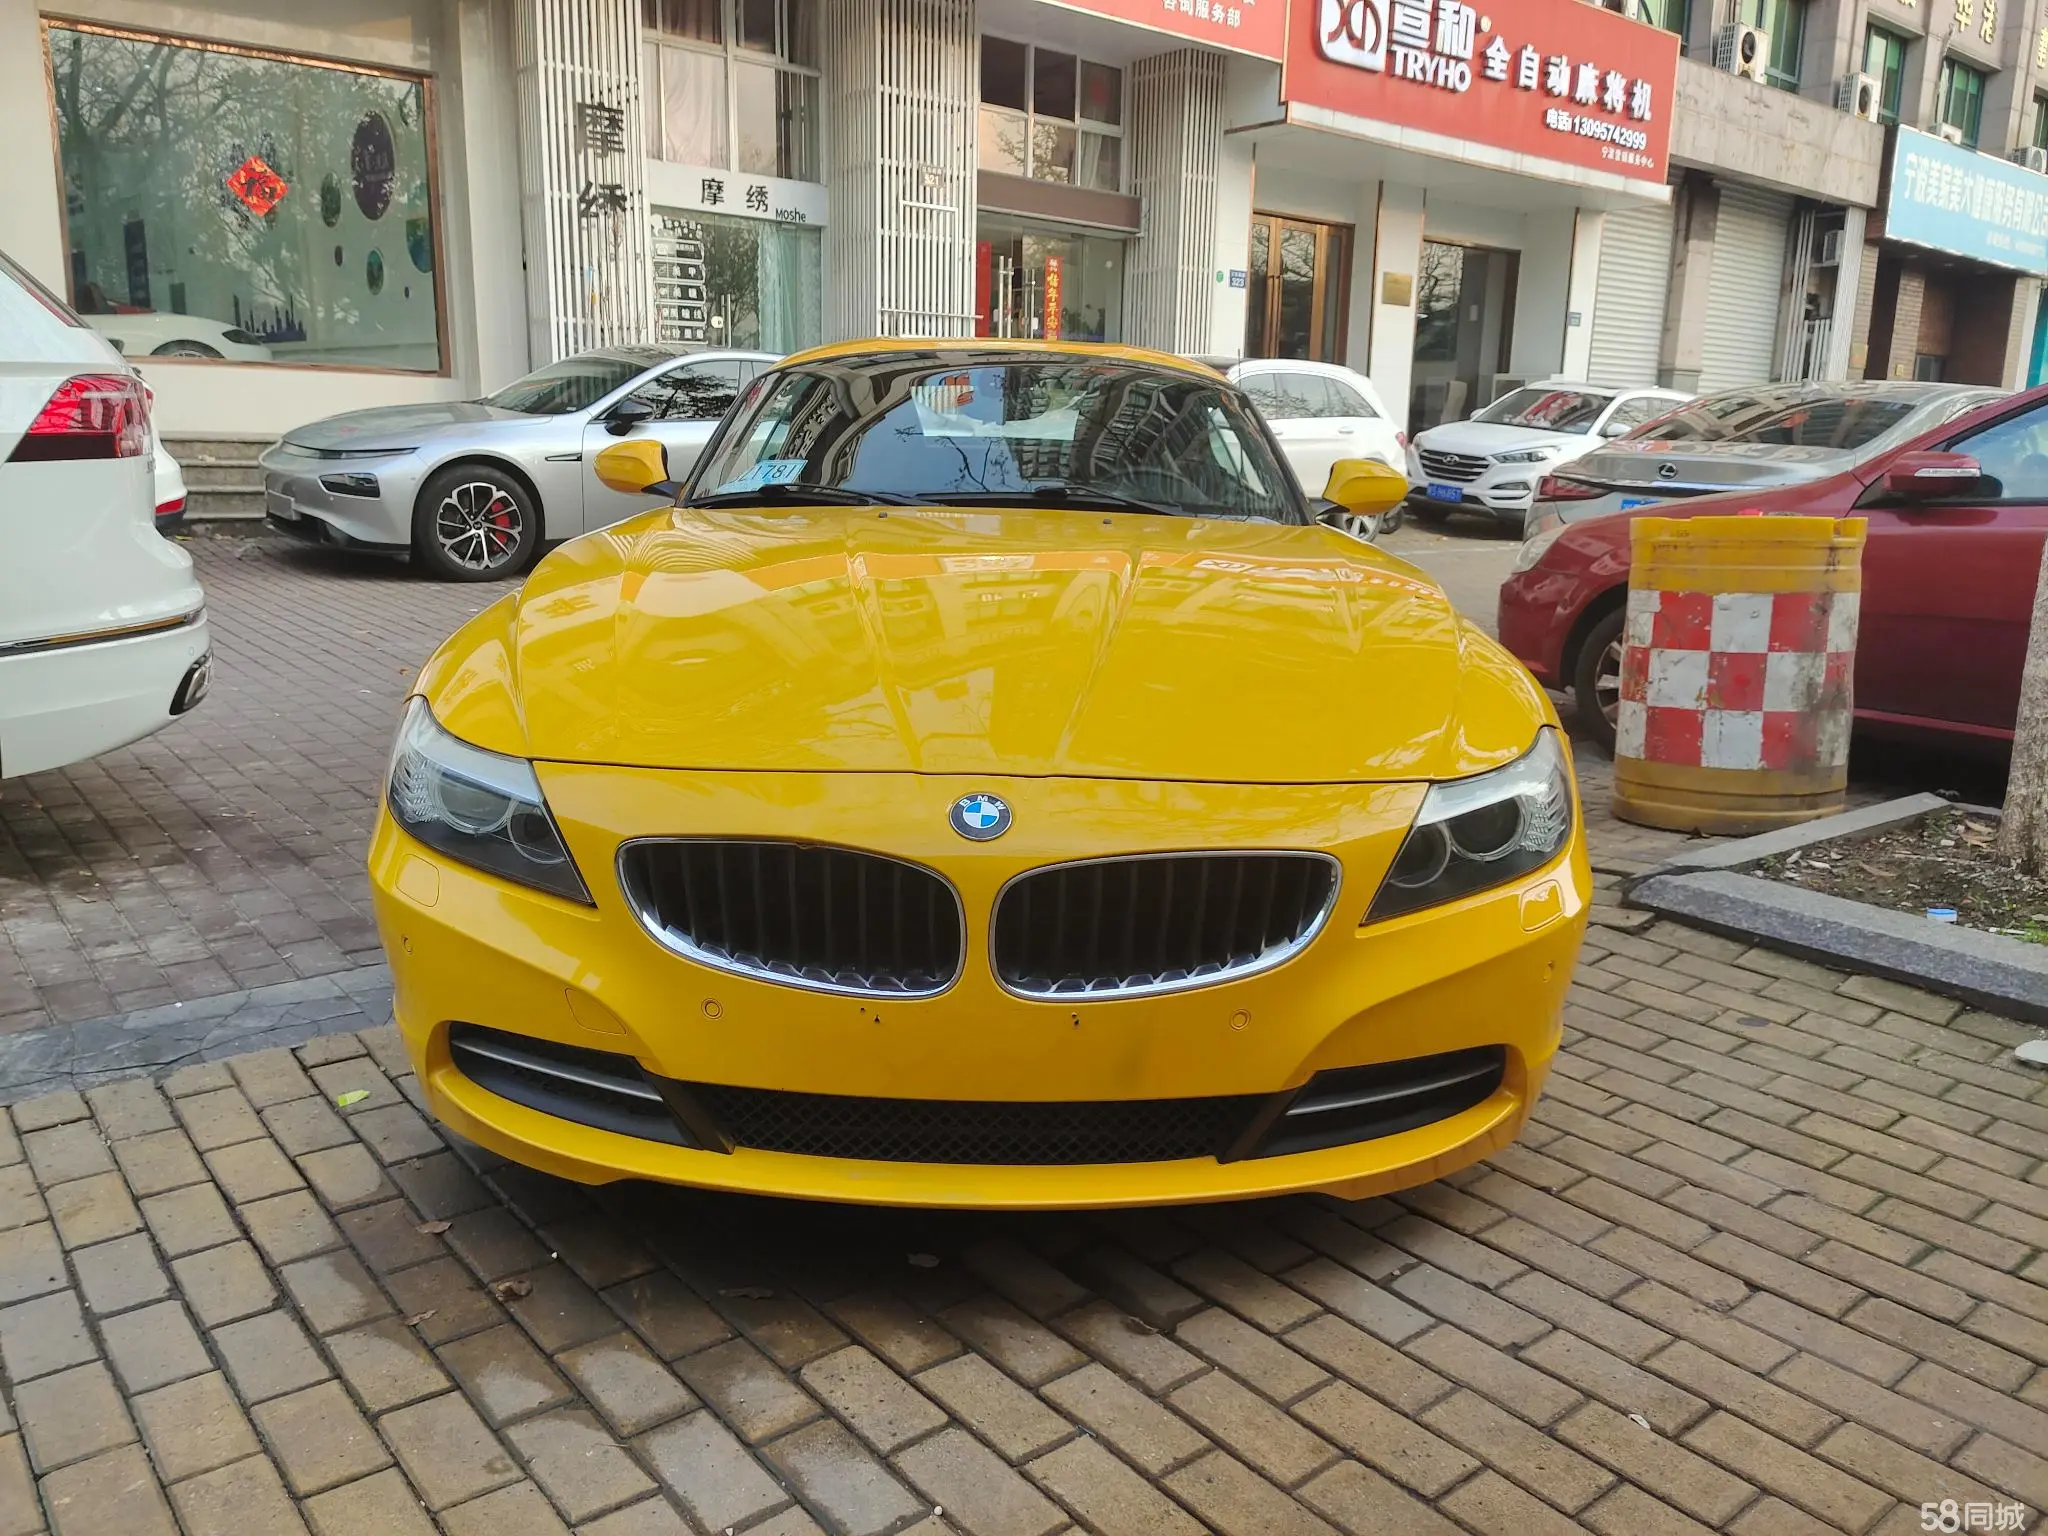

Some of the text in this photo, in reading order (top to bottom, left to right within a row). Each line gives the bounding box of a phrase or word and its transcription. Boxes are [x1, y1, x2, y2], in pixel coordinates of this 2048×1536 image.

[1390, 45, 1473, 93] TRYHO
[1482, 36, 1653, 121] 全自动麻将机
[700, 178, 769, 213] 摩绣
[775, 207, 807, 223] Moshe
[958, 795, 1007, 811] BMW
